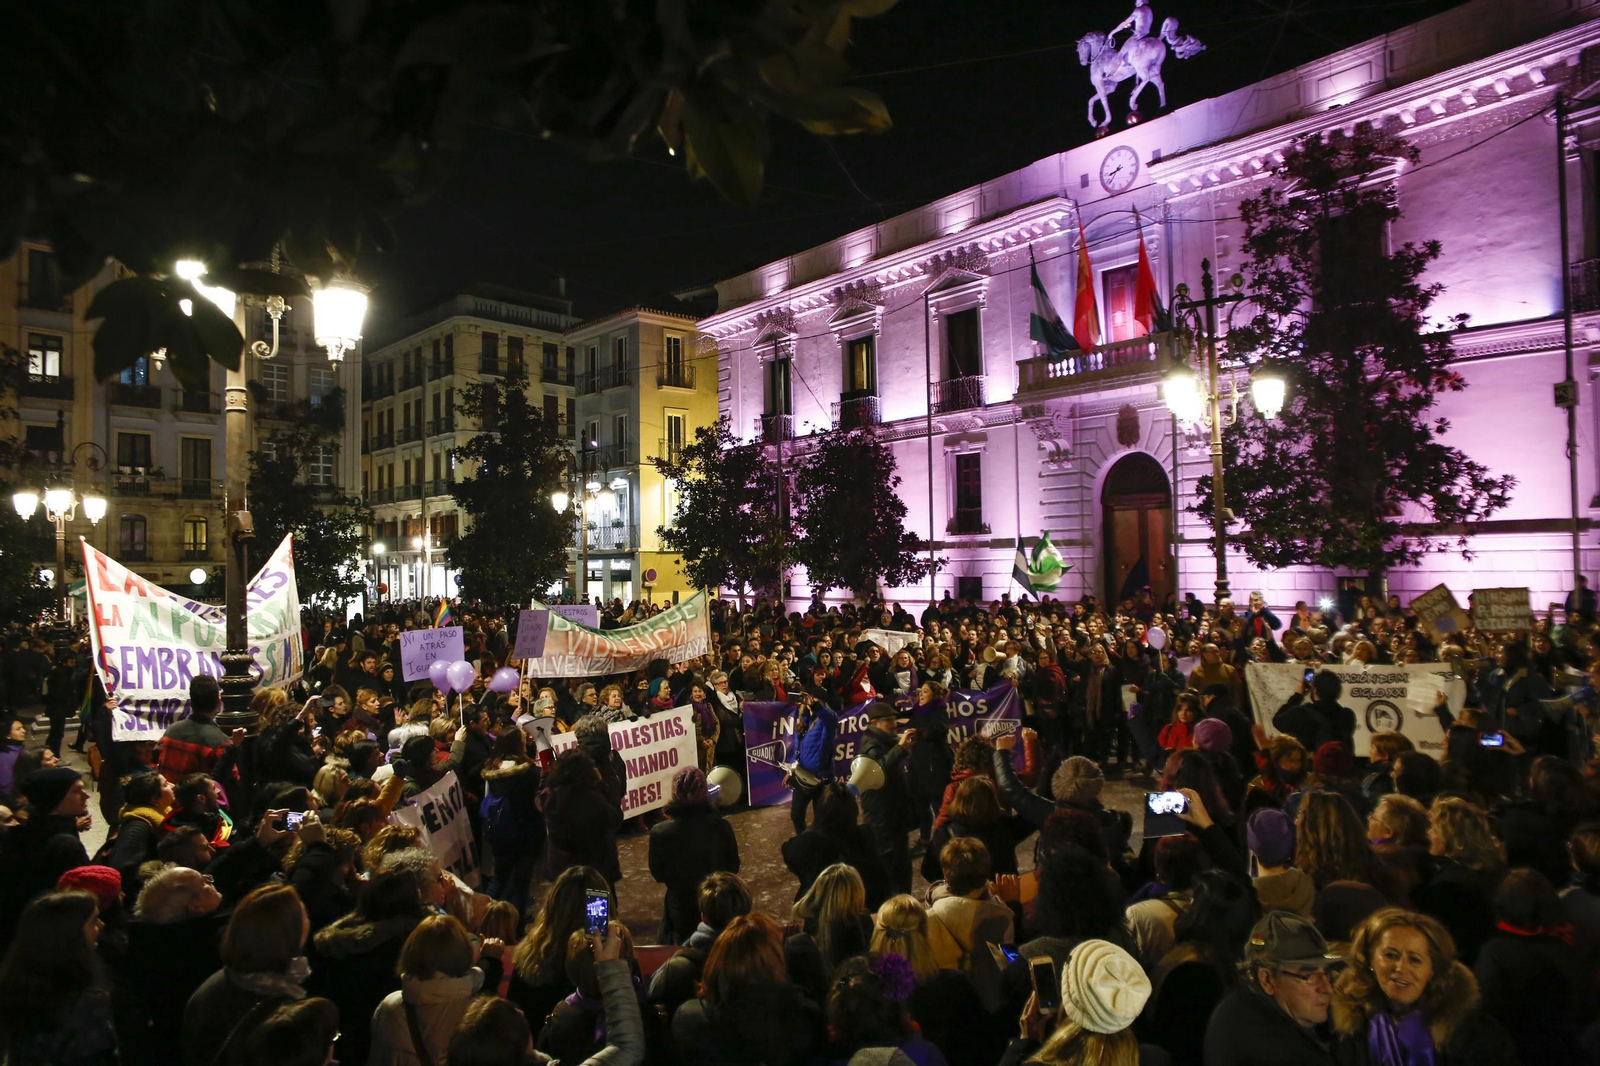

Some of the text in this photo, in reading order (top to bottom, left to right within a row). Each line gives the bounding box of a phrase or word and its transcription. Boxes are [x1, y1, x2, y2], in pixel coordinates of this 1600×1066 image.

[97, 603, 123, 627] LA
[423, 632, 433, 641] UN
[440, 630, 457, 639] PASO
[567, 620, 688, 658] VIOLENCIA
[426, 652, 436, 660] EN
[1378, 673, 1396, 684] DE
[1351, 687, 1407, 699] SIGLO XXI
[611, 716, 687, 752] OLESTIAS,
[752, 745, 776, 761] GUADIX
[834, 742, 854, 761] SE
[625, 747, 679, 780] NANDO
[620, 780, 662, 812] ERES!
